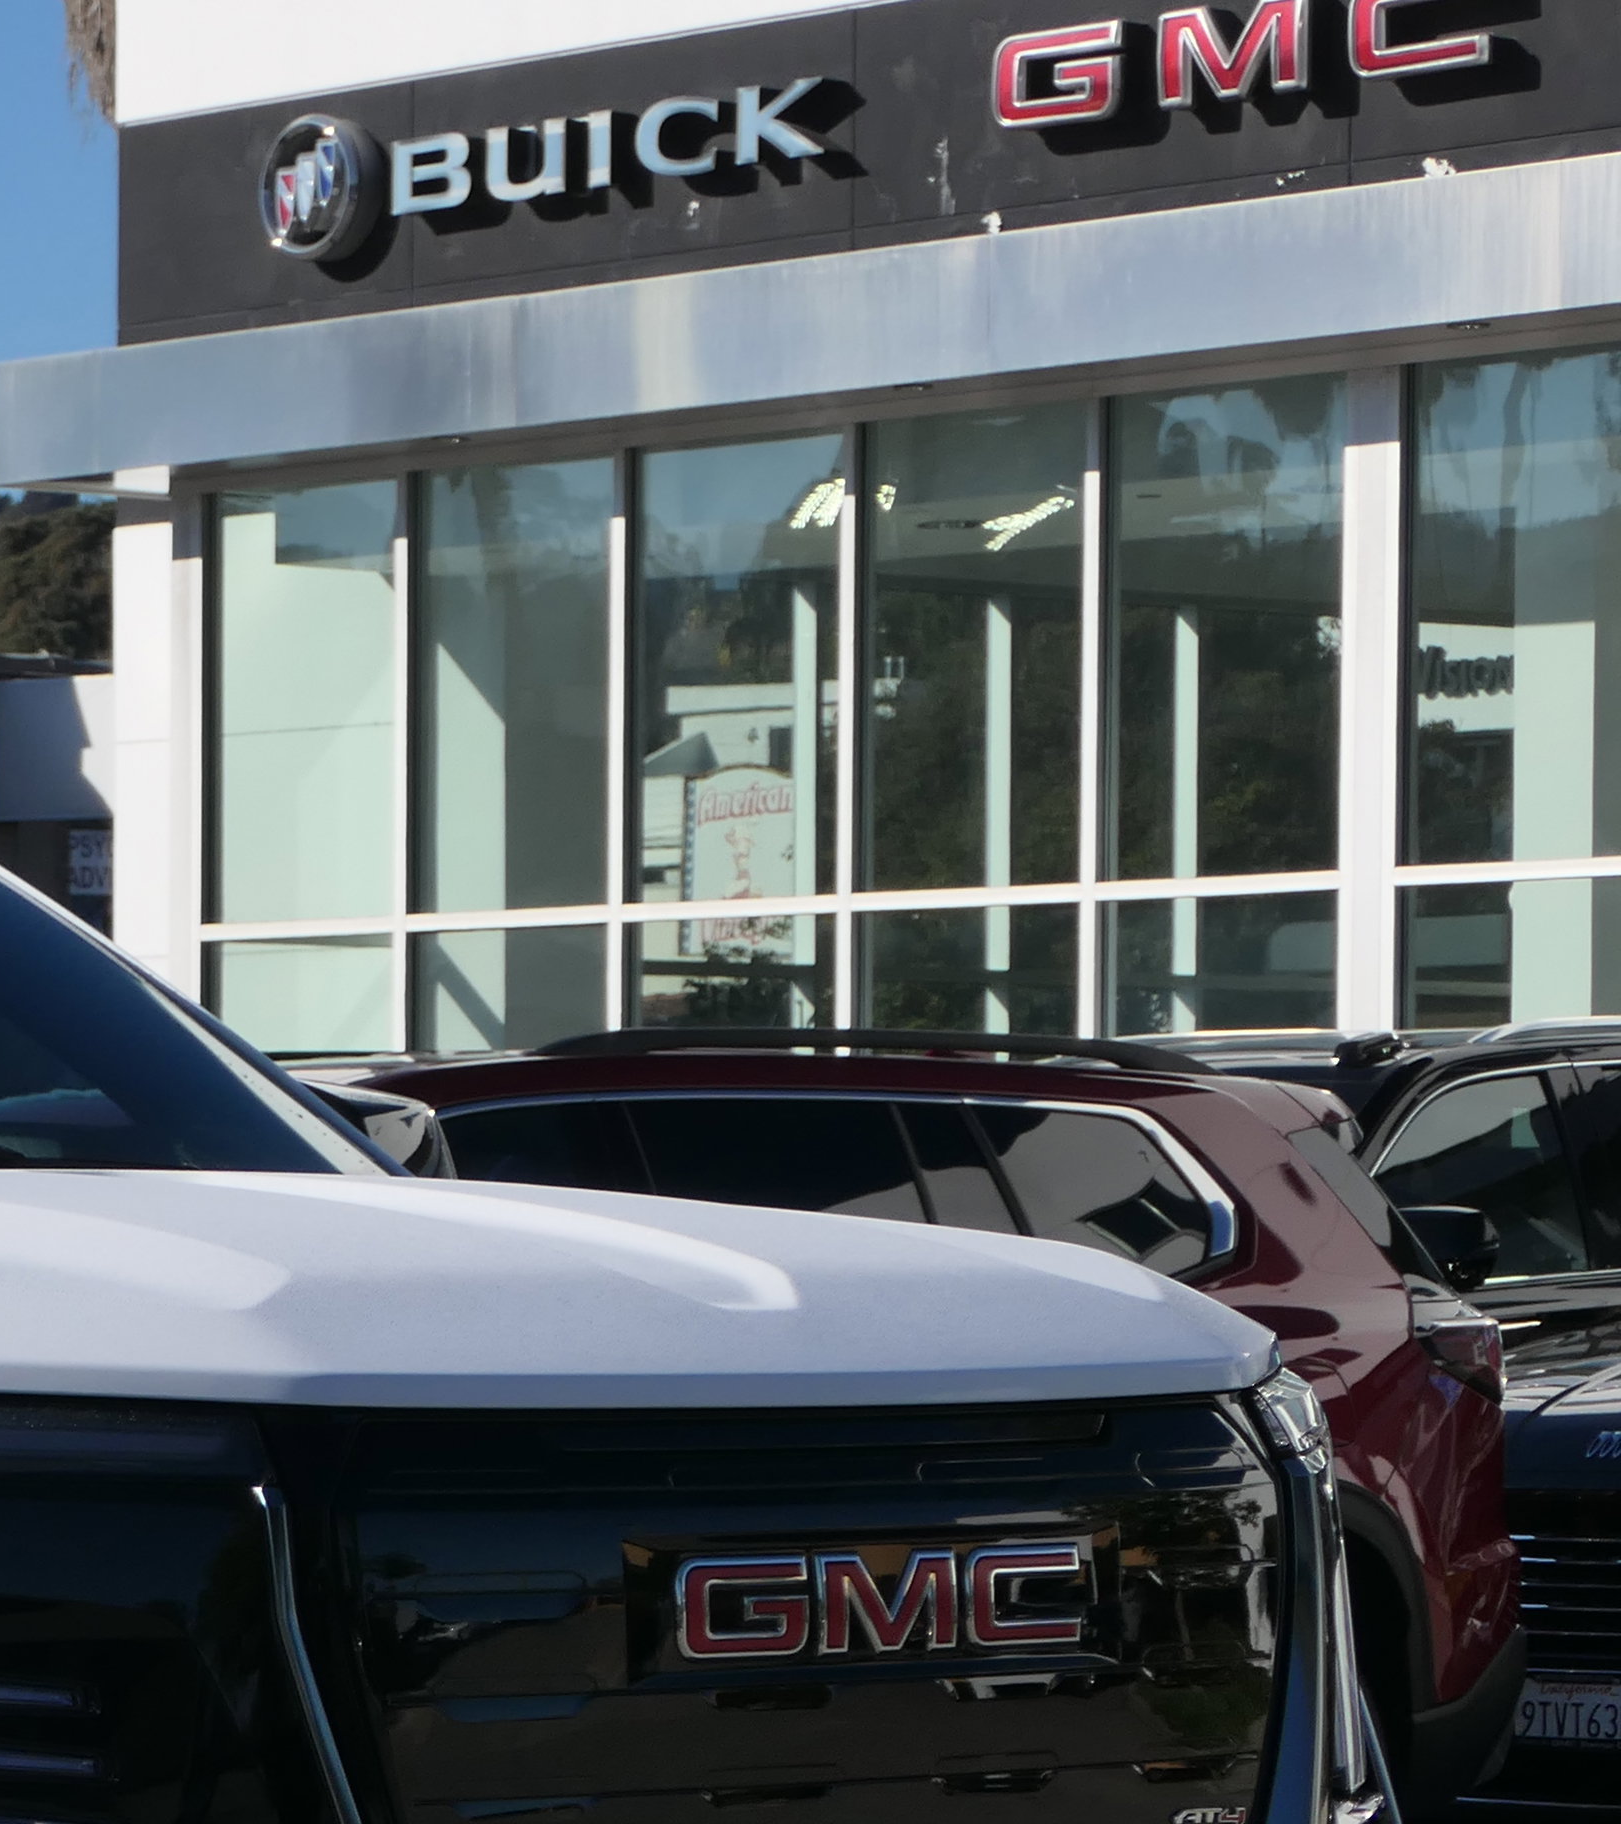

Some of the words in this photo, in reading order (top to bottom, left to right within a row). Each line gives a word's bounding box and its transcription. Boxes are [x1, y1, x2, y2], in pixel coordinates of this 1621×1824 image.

[992, 0, 1490, 127] GMC
[390, 76, 825, 216] BUICK
[675, 1542, 1082, 1658] GMC
